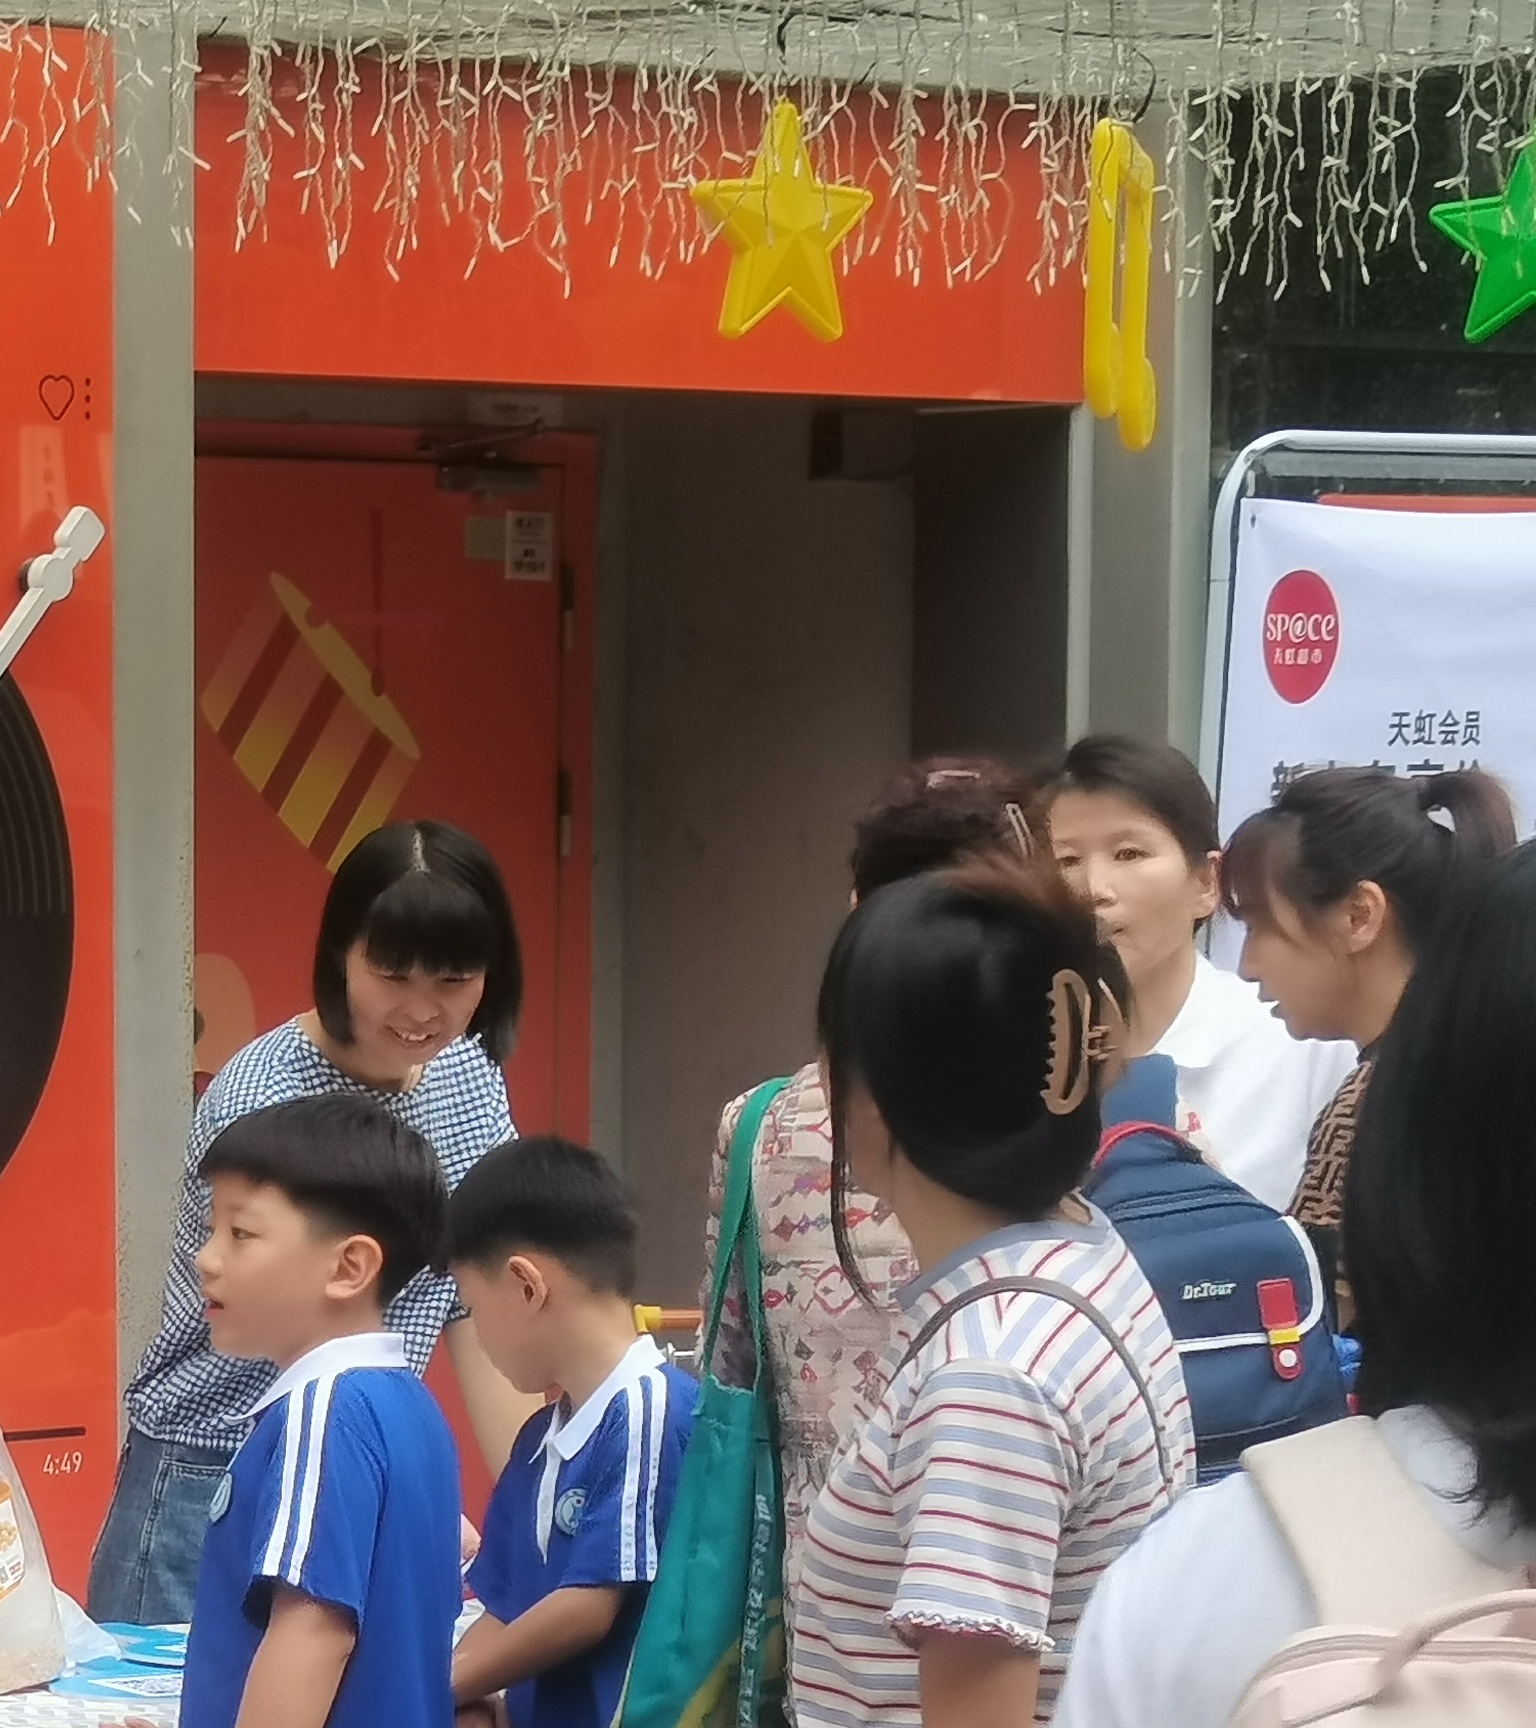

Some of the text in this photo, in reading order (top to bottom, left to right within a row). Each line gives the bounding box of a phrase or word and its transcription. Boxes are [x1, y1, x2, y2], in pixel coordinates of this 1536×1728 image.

[1387, 709, 1481, 746] 天虹会员
[43, 1452, 82, 1475] 4:49
